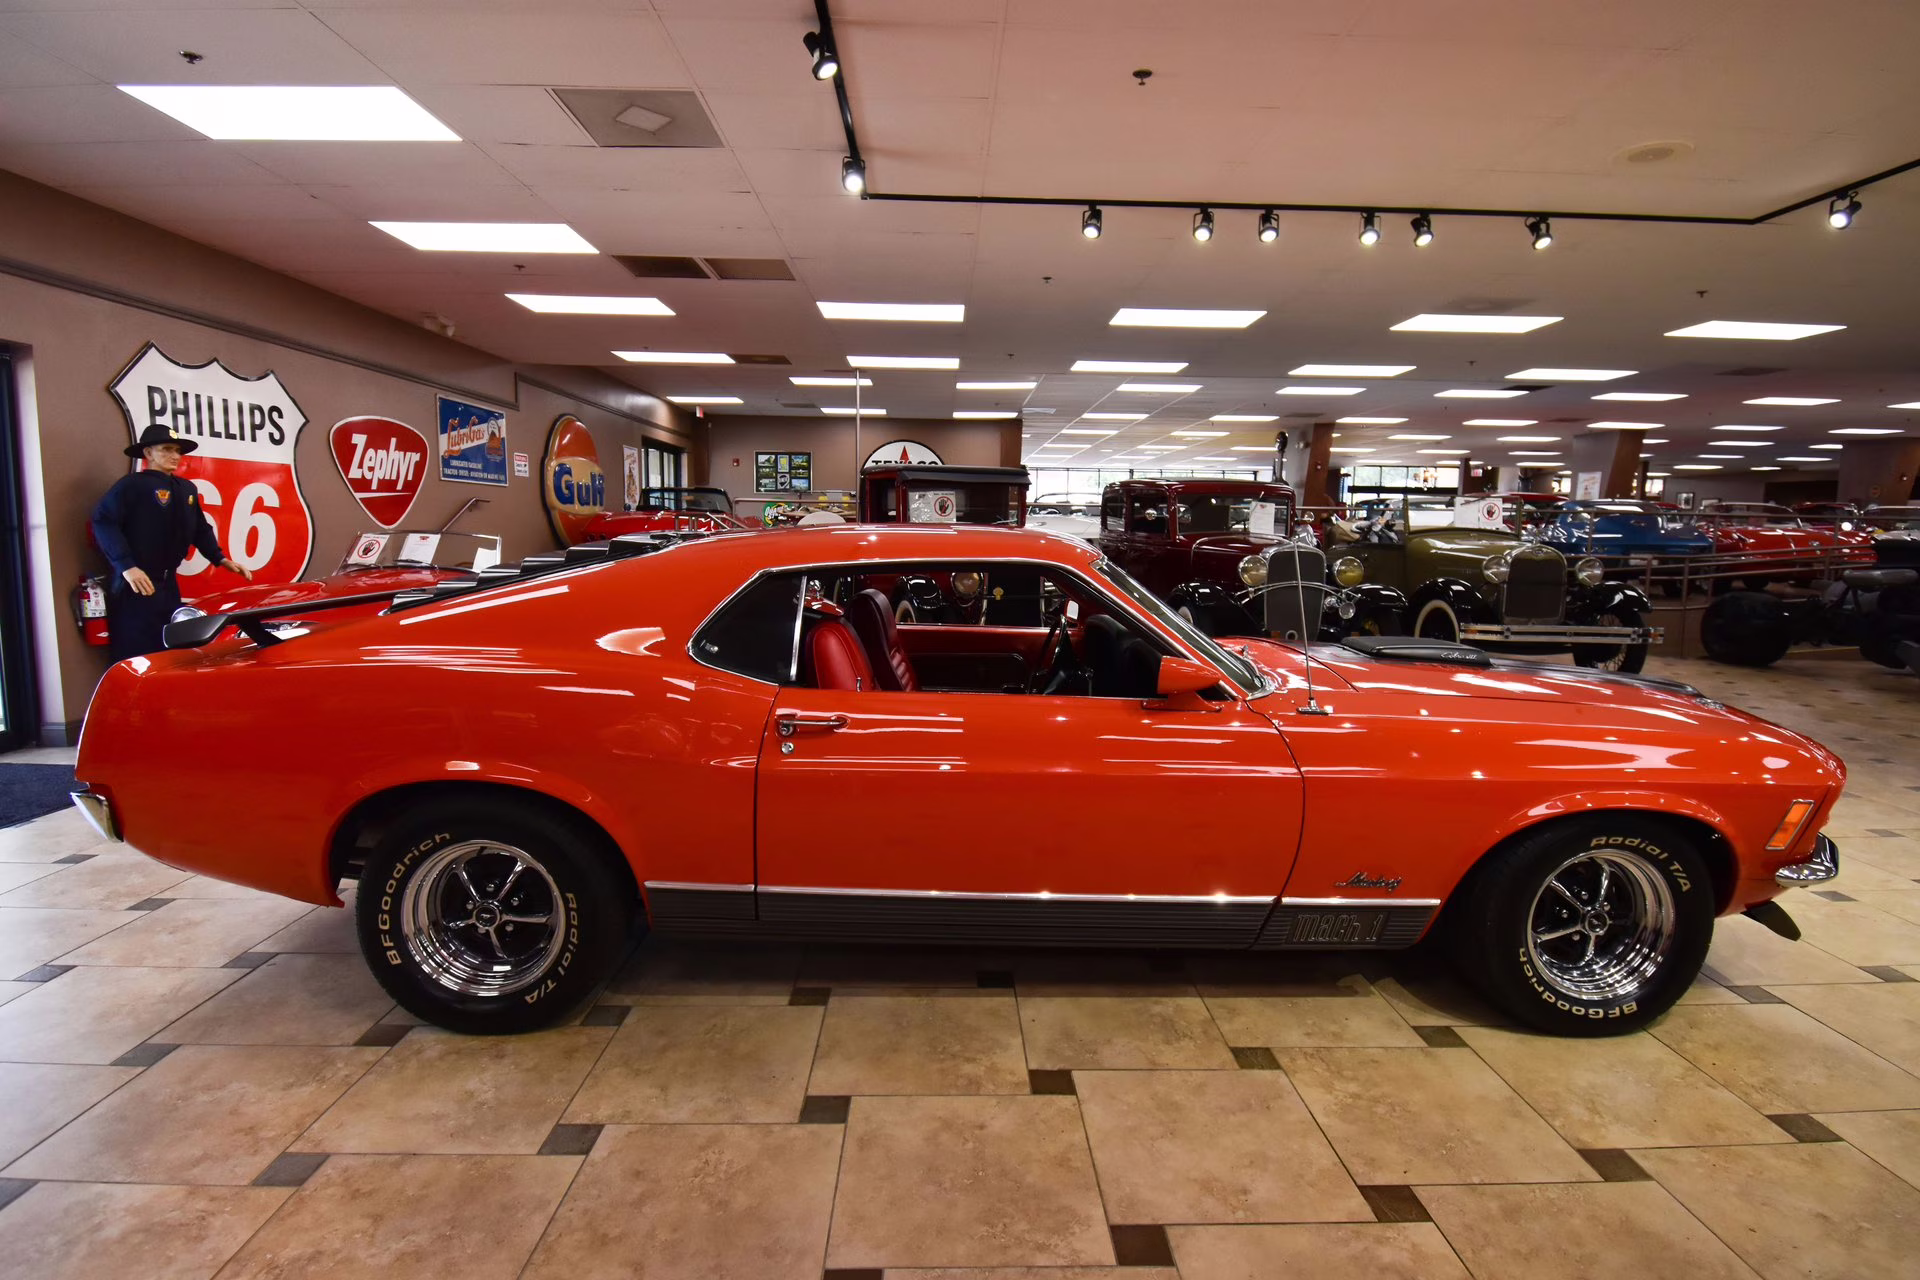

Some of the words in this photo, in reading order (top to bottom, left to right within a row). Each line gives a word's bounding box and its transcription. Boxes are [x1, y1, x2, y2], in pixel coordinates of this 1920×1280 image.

[147, 385, 285, 446] PHILLIPS
[348, 433, 421, 490] Zephyr
[553, 463, 606, 507] Gulf
[1590, 836, 1669, 861] Radial
[1669, 861, 1692, 893] T/A
[557, 892, 579, 976] Radial
[524, 979, 558, 1004] T/A
